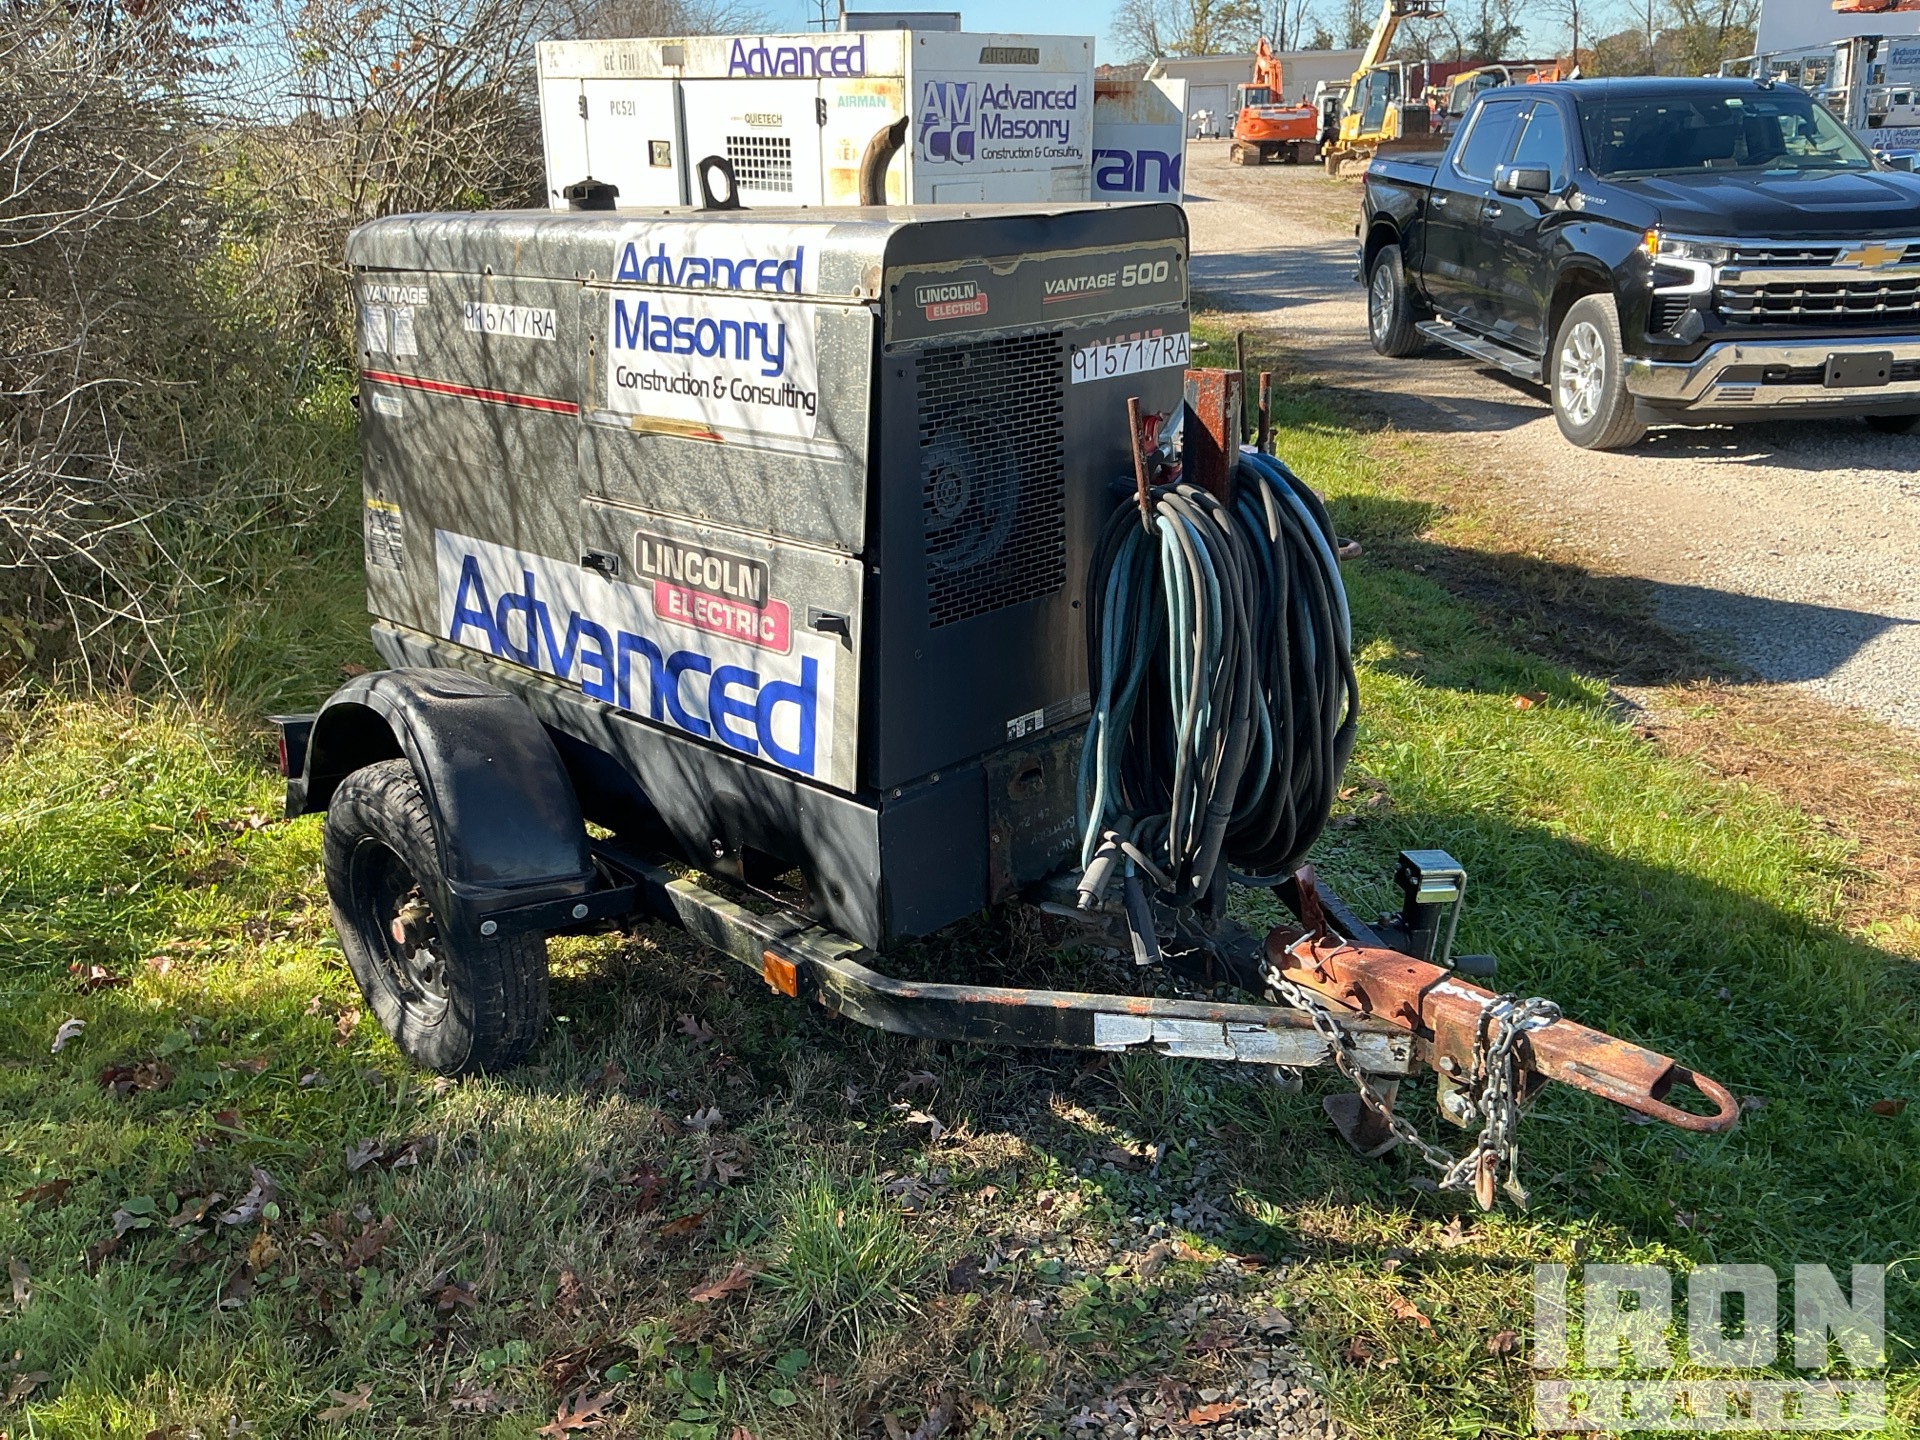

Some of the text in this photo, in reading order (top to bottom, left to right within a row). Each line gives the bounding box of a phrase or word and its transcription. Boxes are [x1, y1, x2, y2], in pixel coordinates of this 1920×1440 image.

[728, 34, 865, 77] Advanced
[982, 48, 1038, 63] AIRMAN
[610, 101, 635, 116] PC521
[838, 95, 886, 108] AIRMAN
[979, 83, 1077, 110] Advanced
[744, 113, 782, 125] QUIETECH
[981, 113, 1070, 145] Masonry
[981, 145, 1083, 160] Construction & Consulting
[616, 242, 804, 293] Advanced
[1045, 261, 1169, 294] VANTAGE 500
[363, 284, 428, 306] VANTAGE
[919, 285, 974, 303] LINCOLN
[933, 301, 981, 317] ELECTRIC
[615, 299, 785, 378] Masonry
[1073, 333, 1188, 379] 915717RA
[617, 366, 815, 416] Construction & Consulting
[642, 540, 760, 600] LINCOLN
[668, 589, 775, 641] ELECTRIC
[449, 554, 818, 776] Advanced
